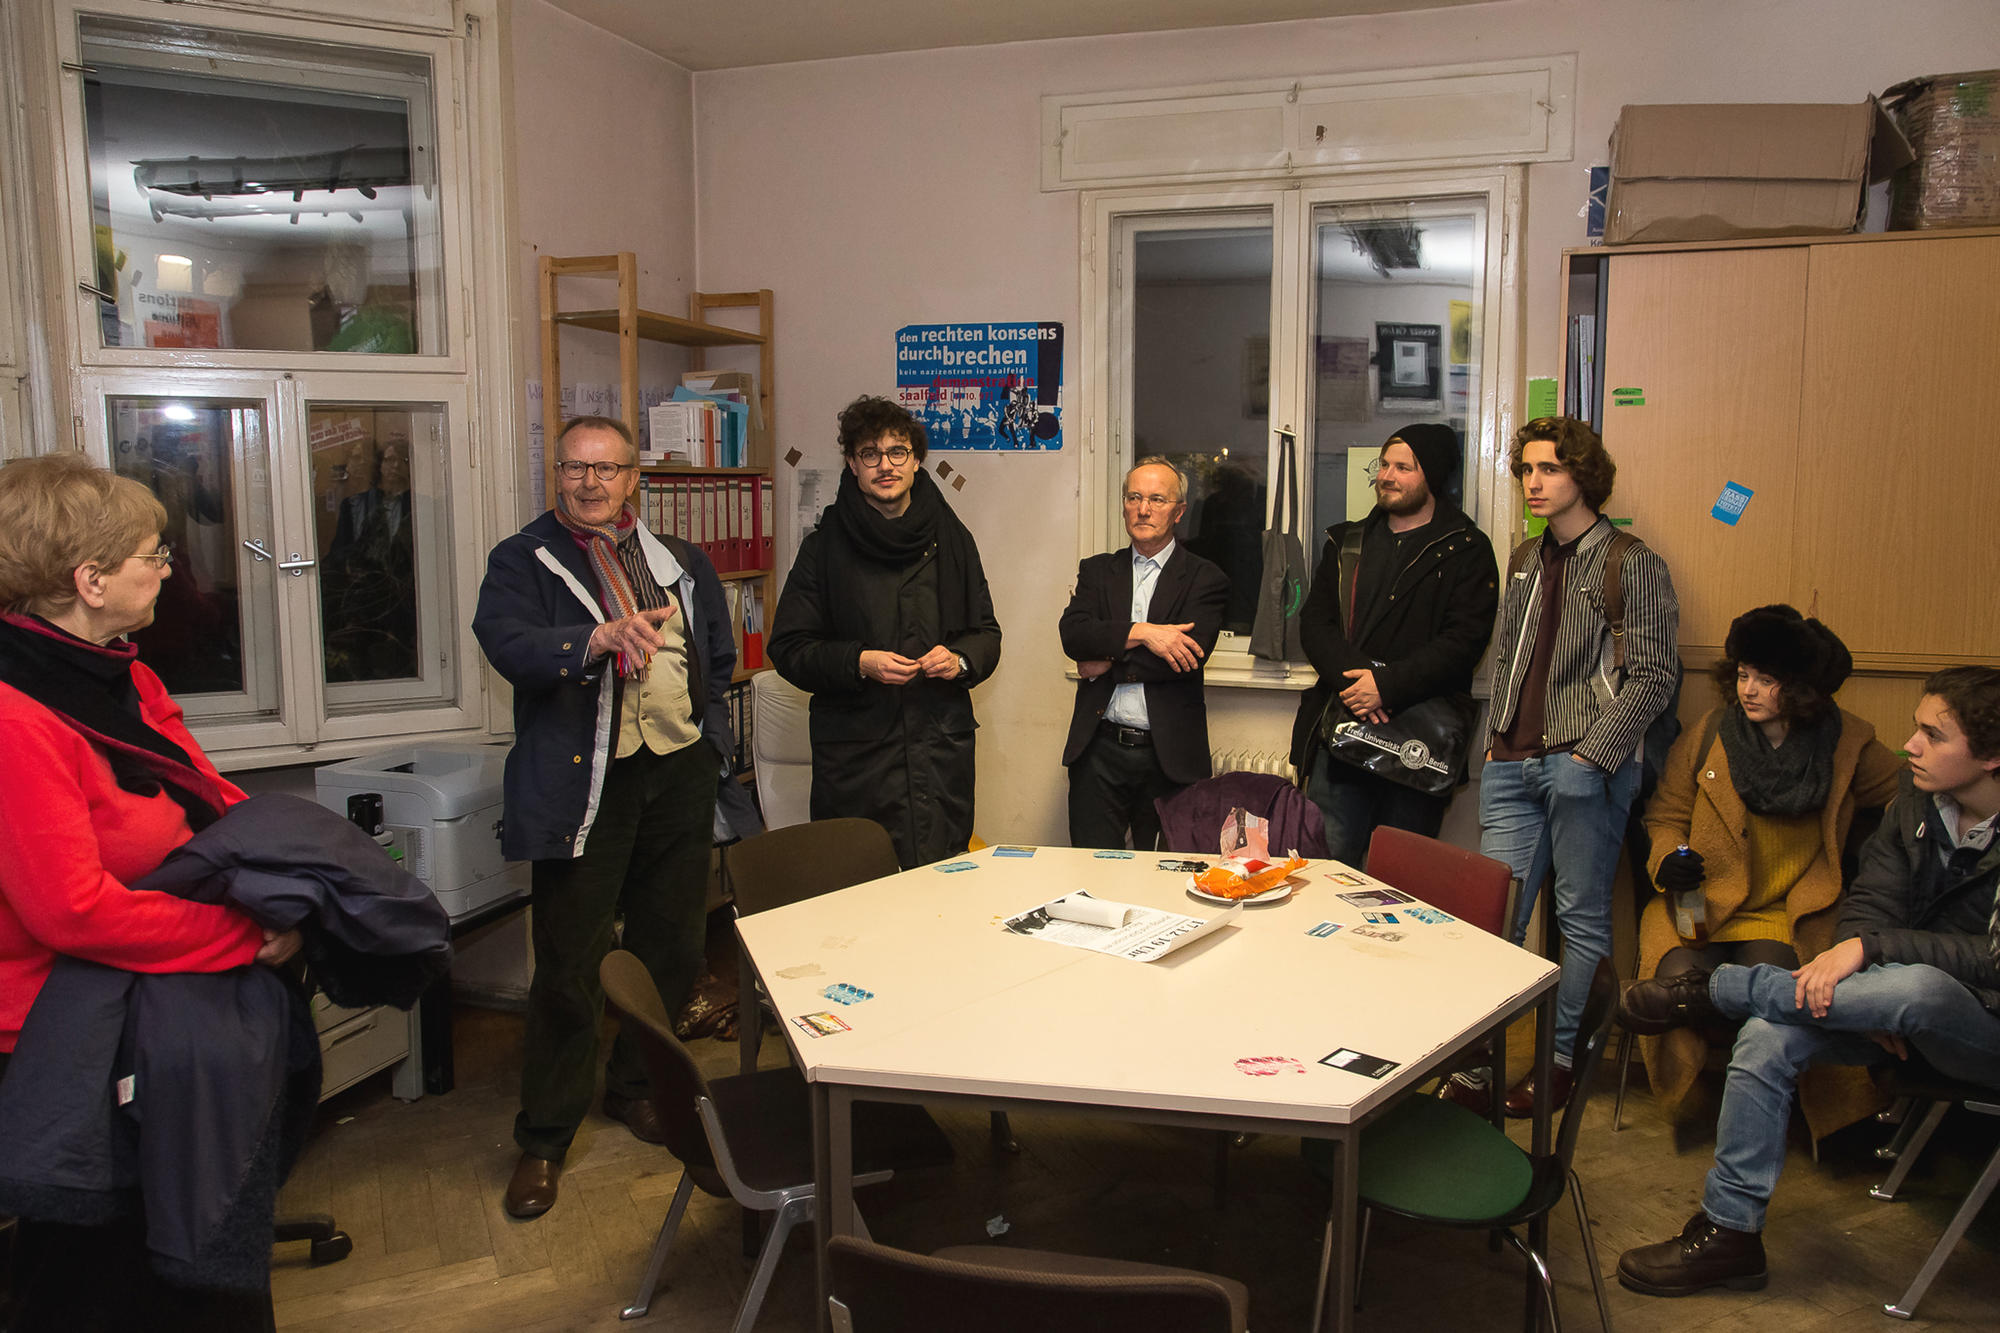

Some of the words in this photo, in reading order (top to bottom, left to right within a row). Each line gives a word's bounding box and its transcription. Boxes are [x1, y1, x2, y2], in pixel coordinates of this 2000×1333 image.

[899, 333, 918, 343] den
[921, 326, 983, 343] rechten
[988, 325, 1057, 341] konsens
[899, 345, 1027, 366] durchbrechen
[899, 368, 917, 376] kein
[920, 368, 974, 376] nazizentrum
[976, 367, 985, 375] in
[987, 366, 1028, 375] saalfeld!
[932, 374, 1035, 388] demonstration
[899, 389, 948, 401] saalfeld
[1347, 727, 1364, 738] Freie
[1364, 732, 1400, 752] Universität
[1428, 757, 1449, 770] Berlin
